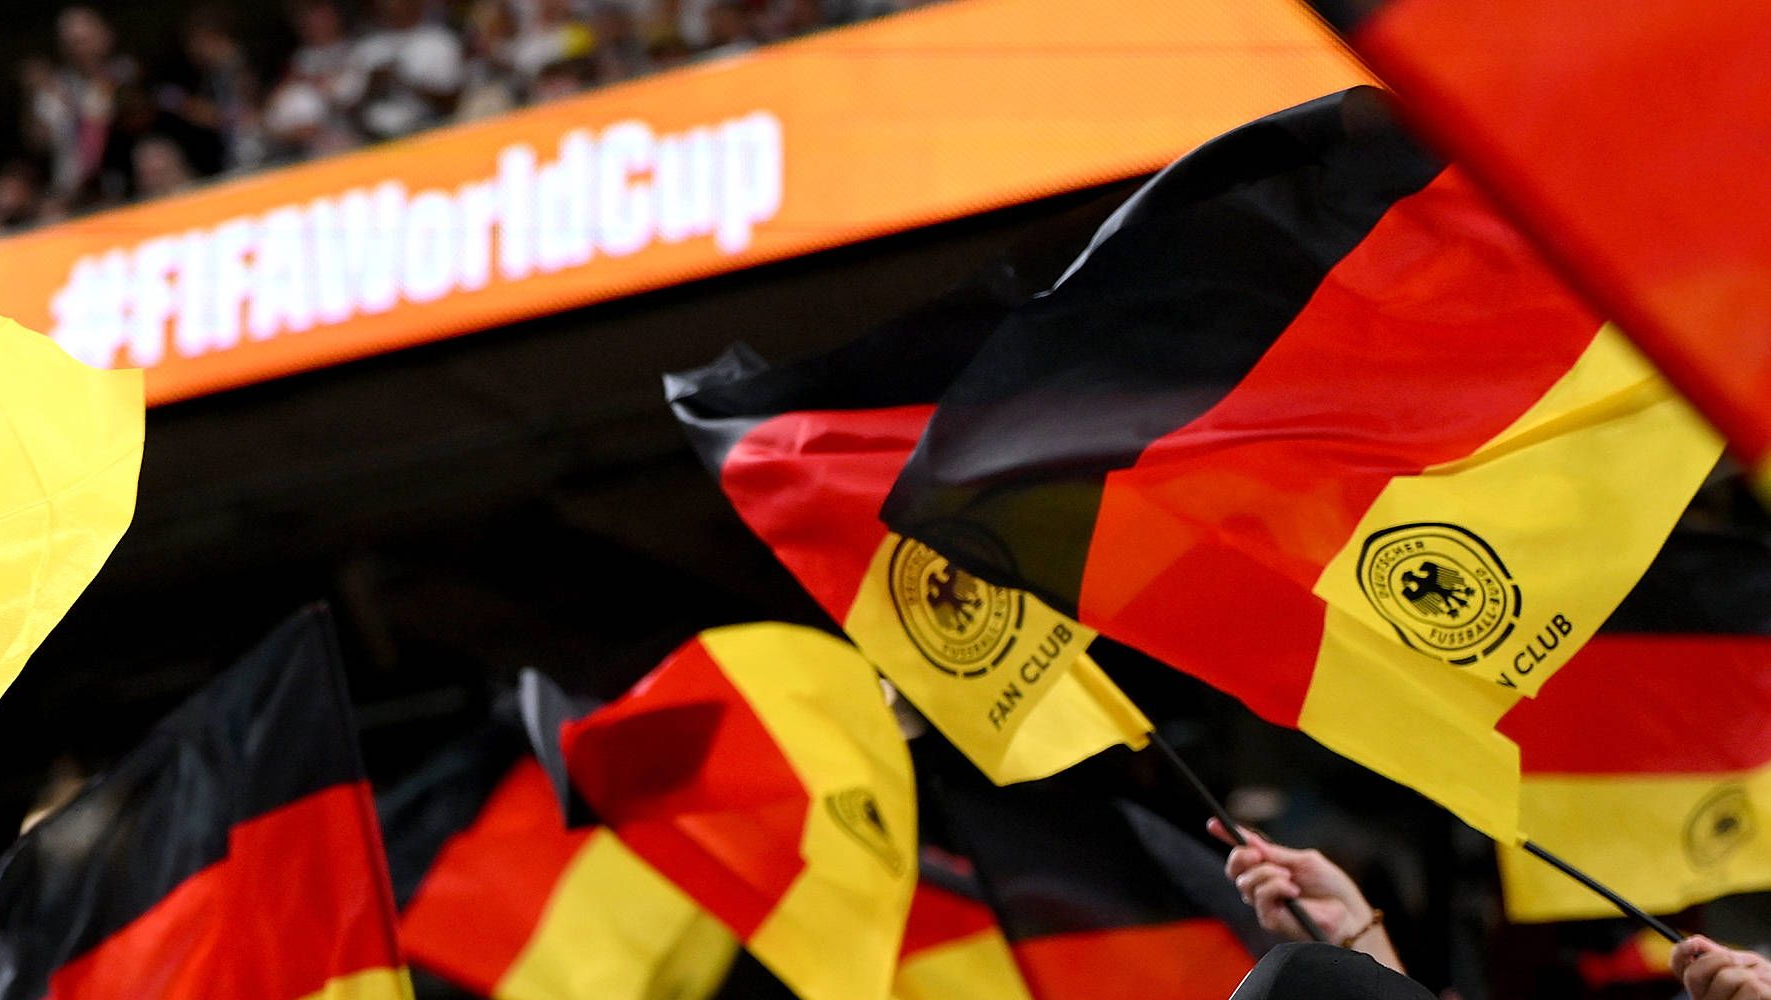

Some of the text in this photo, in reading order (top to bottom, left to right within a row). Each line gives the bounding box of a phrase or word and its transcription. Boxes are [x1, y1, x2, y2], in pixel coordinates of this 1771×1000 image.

[50, 110, 781, 368] #FIFAWorldCup
[1372, 540, 1425, 600] DEUTSCHER
[987, 623, 1074, 732] FAN CLUB
[1513, 614, 1573, 676] CLUB
